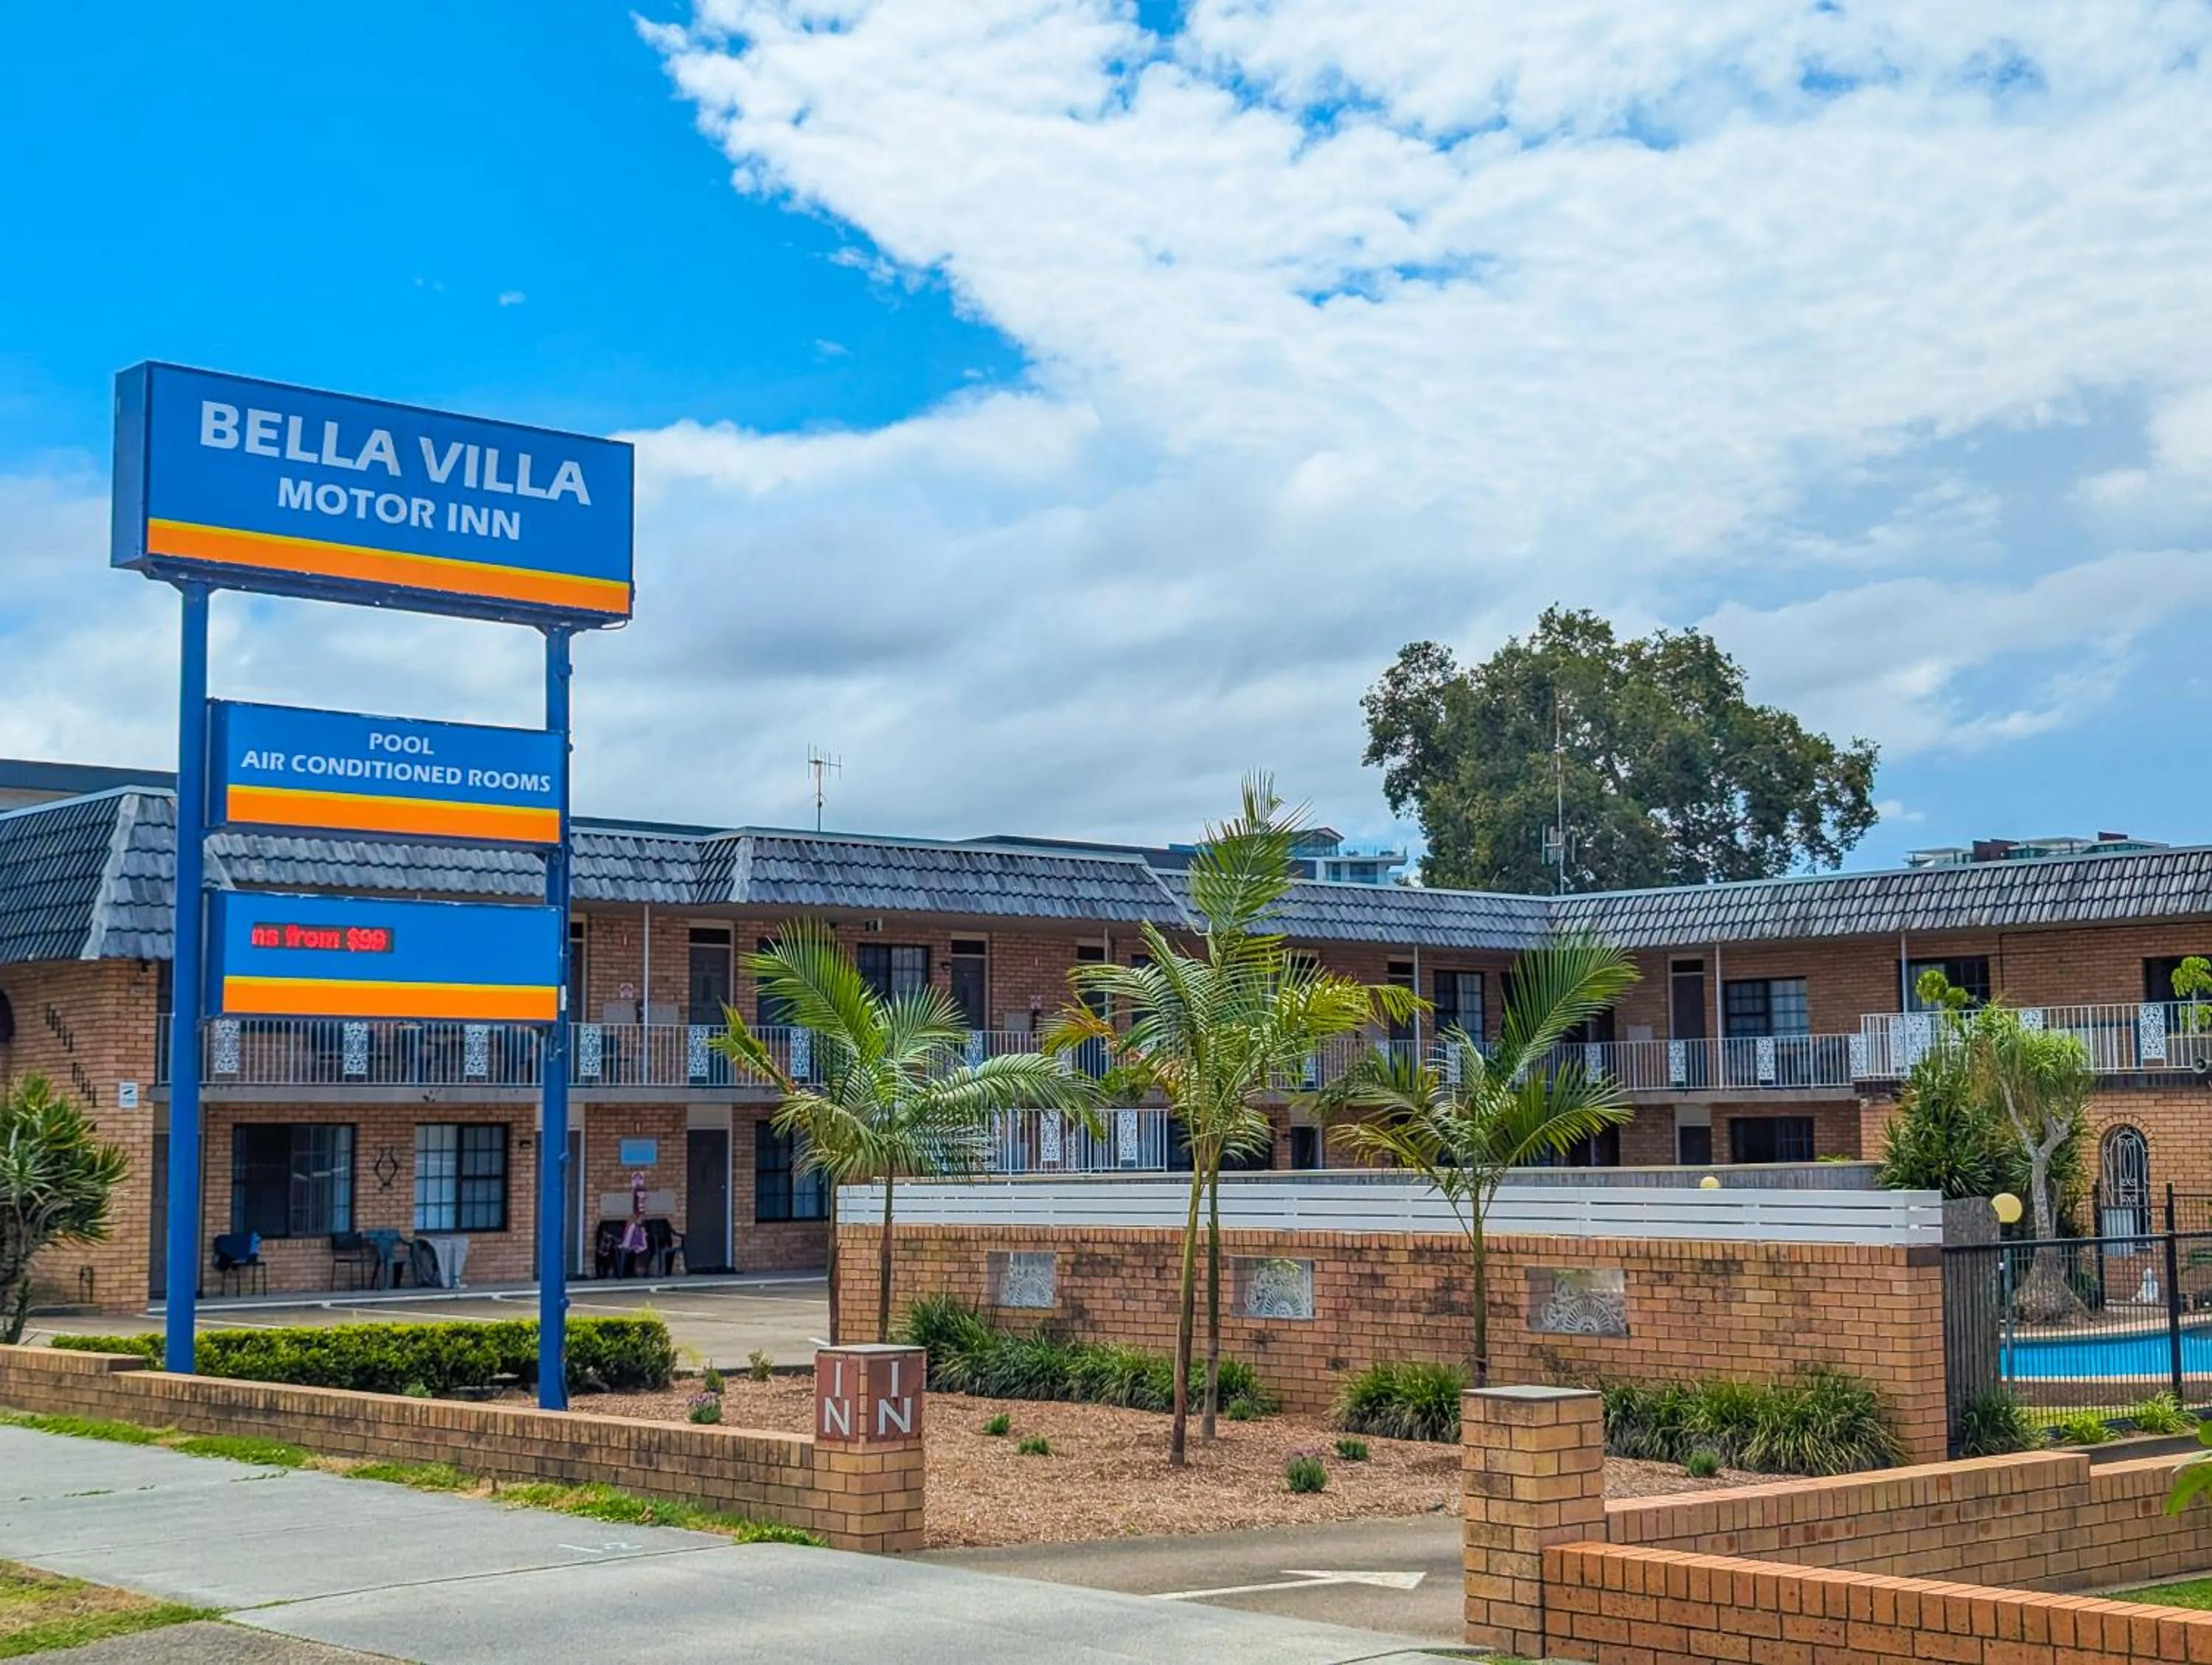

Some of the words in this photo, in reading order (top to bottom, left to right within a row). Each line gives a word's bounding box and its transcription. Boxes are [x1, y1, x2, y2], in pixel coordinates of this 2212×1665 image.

[200, 400, 402, 477] BELLA
[420, 437, 591, 507] VILLA
[278, 477, 435, 529] MOTOR
[447, 503, 521, 540] INN
[369, 732, 434, 756] POOL
[240, 750, 285, 771] AIR
[291, 754, 462, 786] CONDITIONED
[467, 768, 551, 793] ROOMS
[285, 925, 340, 949] from
[347, 927, 387, 952] $99
